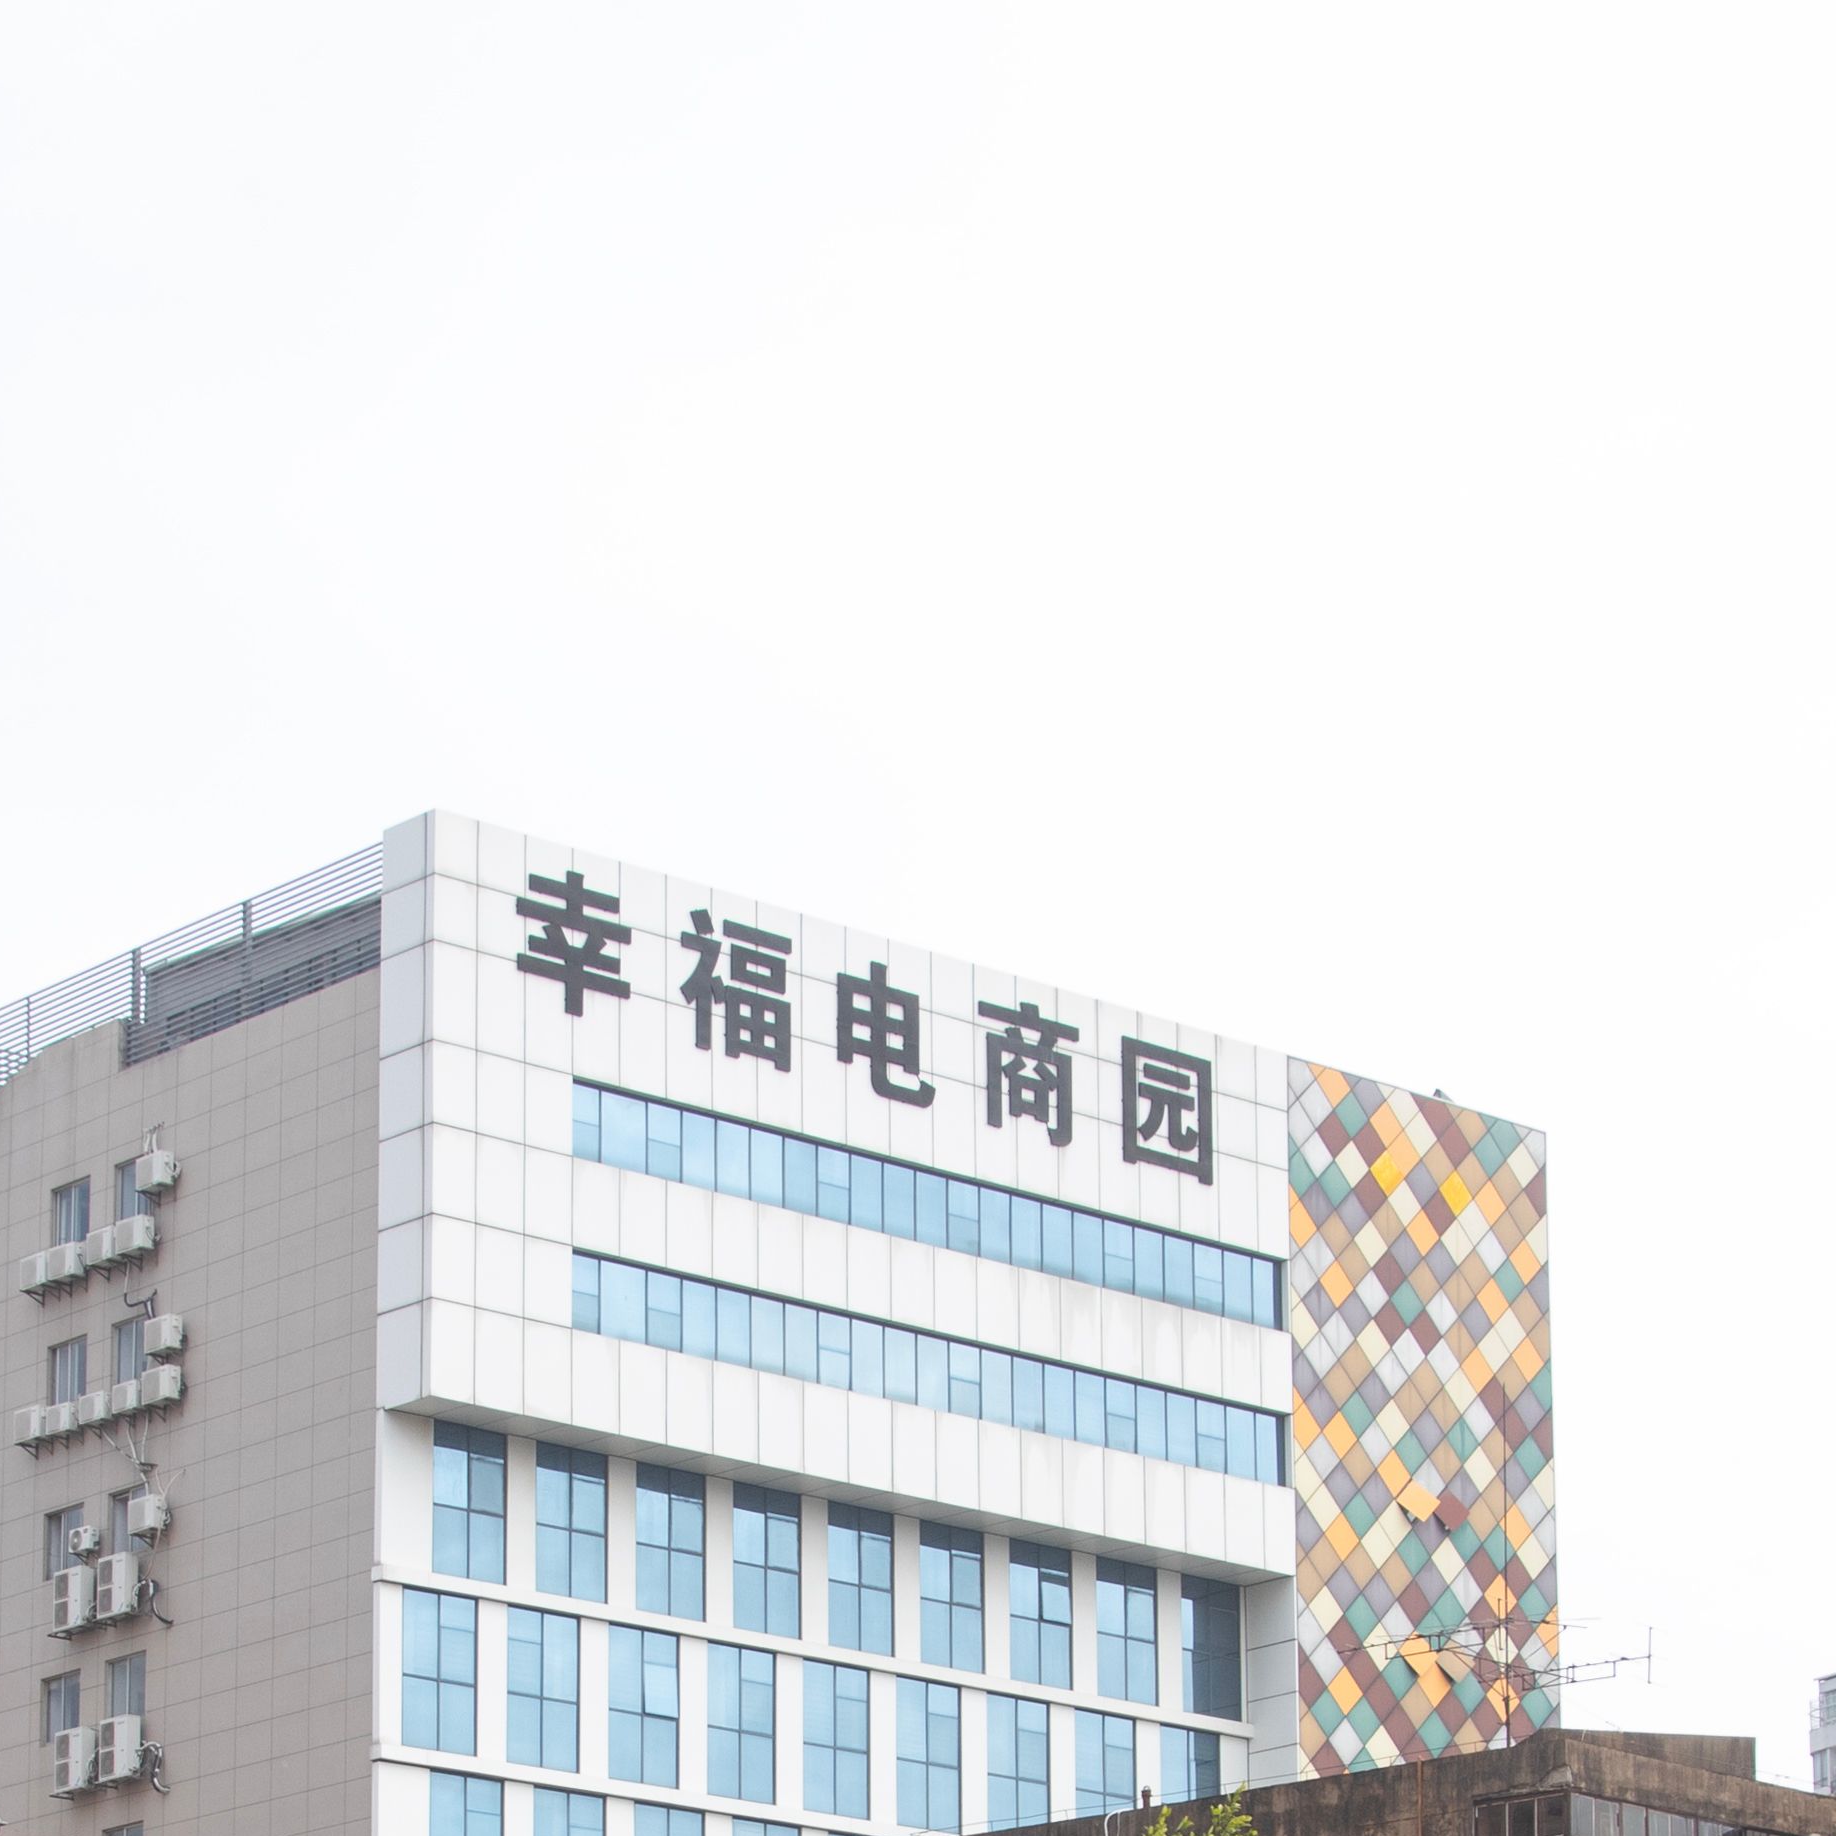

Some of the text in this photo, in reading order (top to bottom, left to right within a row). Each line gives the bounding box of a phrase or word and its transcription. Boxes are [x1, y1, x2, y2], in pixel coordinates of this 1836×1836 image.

[516, 869, 1214, 1186] 幸福电商园
